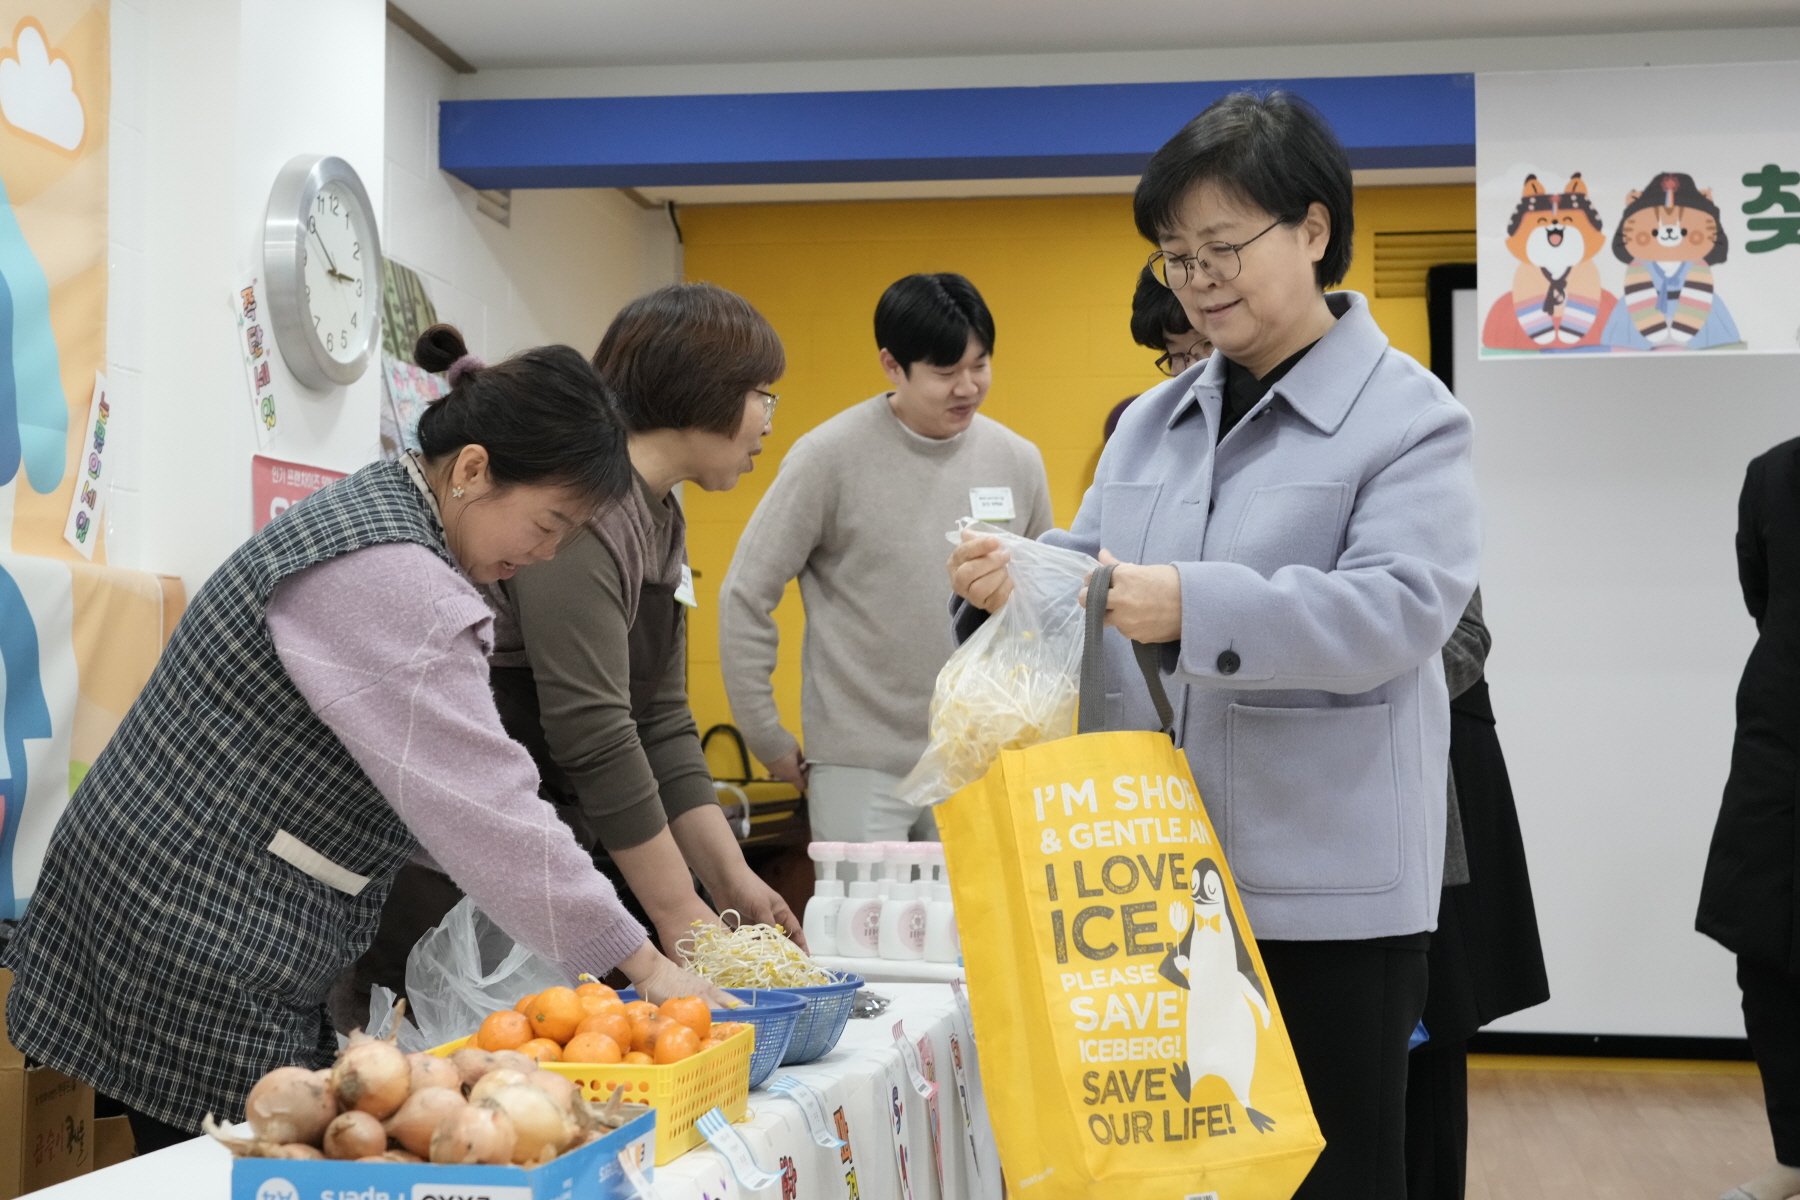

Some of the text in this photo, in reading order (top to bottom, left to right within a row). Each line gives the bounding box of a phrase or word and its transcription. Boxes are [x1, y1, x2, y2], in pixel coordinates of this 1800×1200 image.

[317, 194, 325, 215] 11
[329, 194, 339, 217] 12
[353, 242, 360, 261] 2
[356, 278, 363, 298] 3
[314, 315, 321, 332] 7
[351, 311, 357, 329] 4
[327, 332, 334, 352] 6
[341, 329, 348, 349] 5
[1033, 778, 1099, 822] I'M
[1040, 828, 1063, 855] &
[1068, 817, 1188, 850] GENTLE.
[1045, 853, 1189, 902] I LOVE
[1051, 900, 1174, 965] ICE.
[1060, 964, 1158, 992] PLEASE
[1069, 990, 1181, 1032] SAVE
[1078, 1035, 1182, 1064] ICEBERG!
[1082, 1067, 1167, 1106] SAVE
[1088, 1102, 1237, 1146] OUR LIFE!
